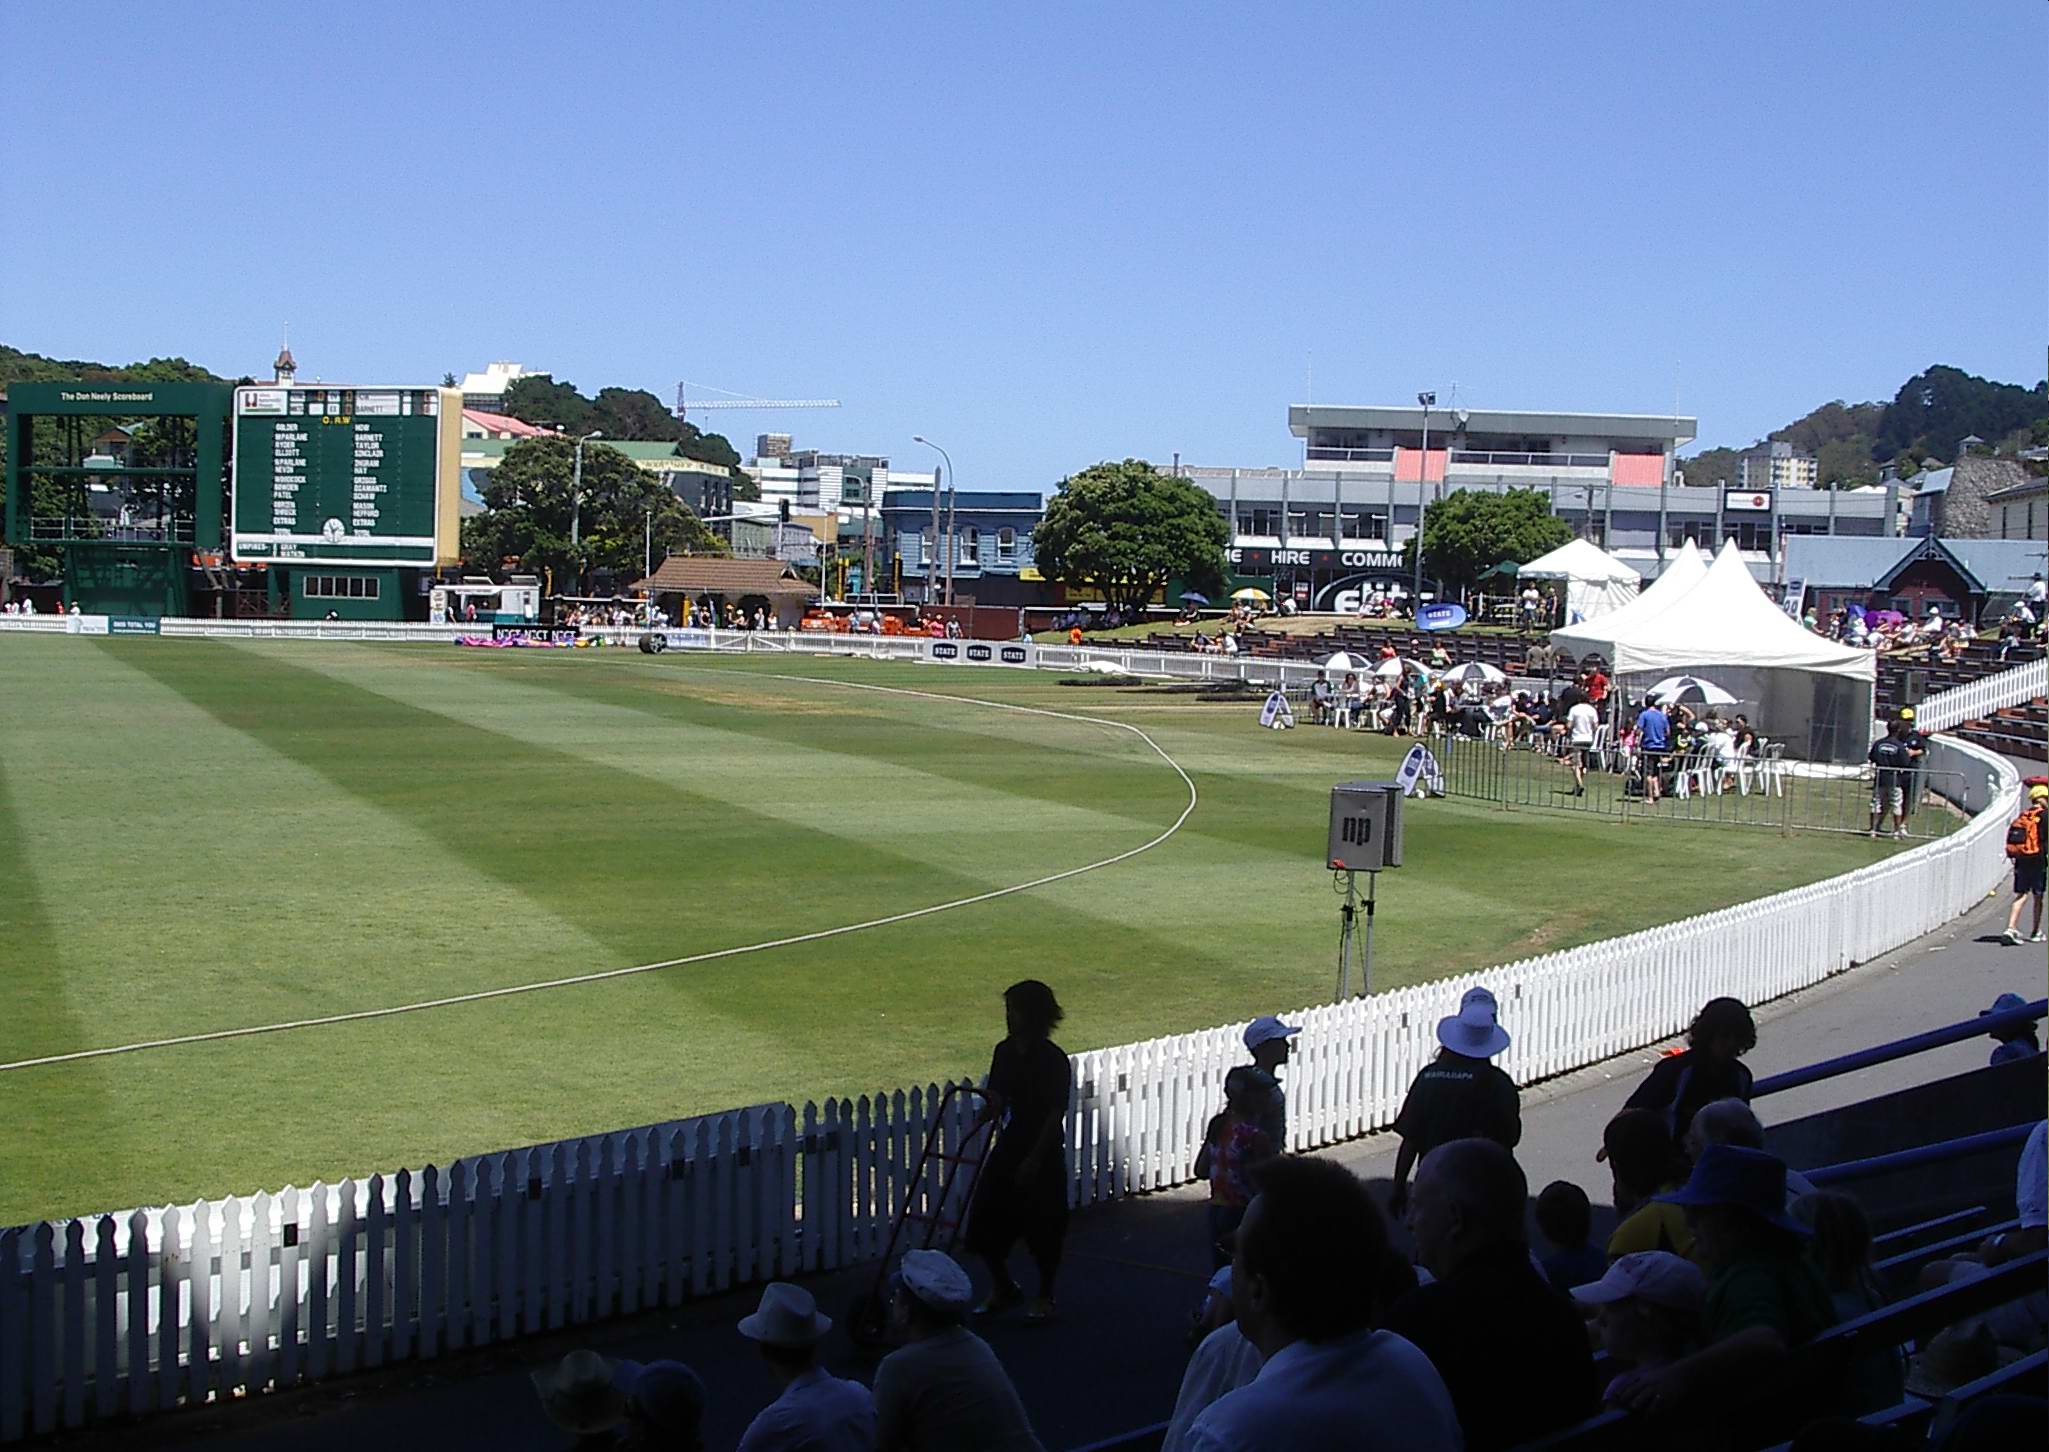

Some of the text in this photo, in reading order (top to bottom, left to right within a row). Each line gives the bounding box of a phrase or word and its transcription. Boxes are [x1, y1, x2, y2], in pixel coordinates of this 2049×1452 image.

[61, 392, 153, 402] The Don Neely Scoreboard
[1271, 550, 1310, 565] HIRE
[934, 647, 1024, 660] STATE STATE STATE
